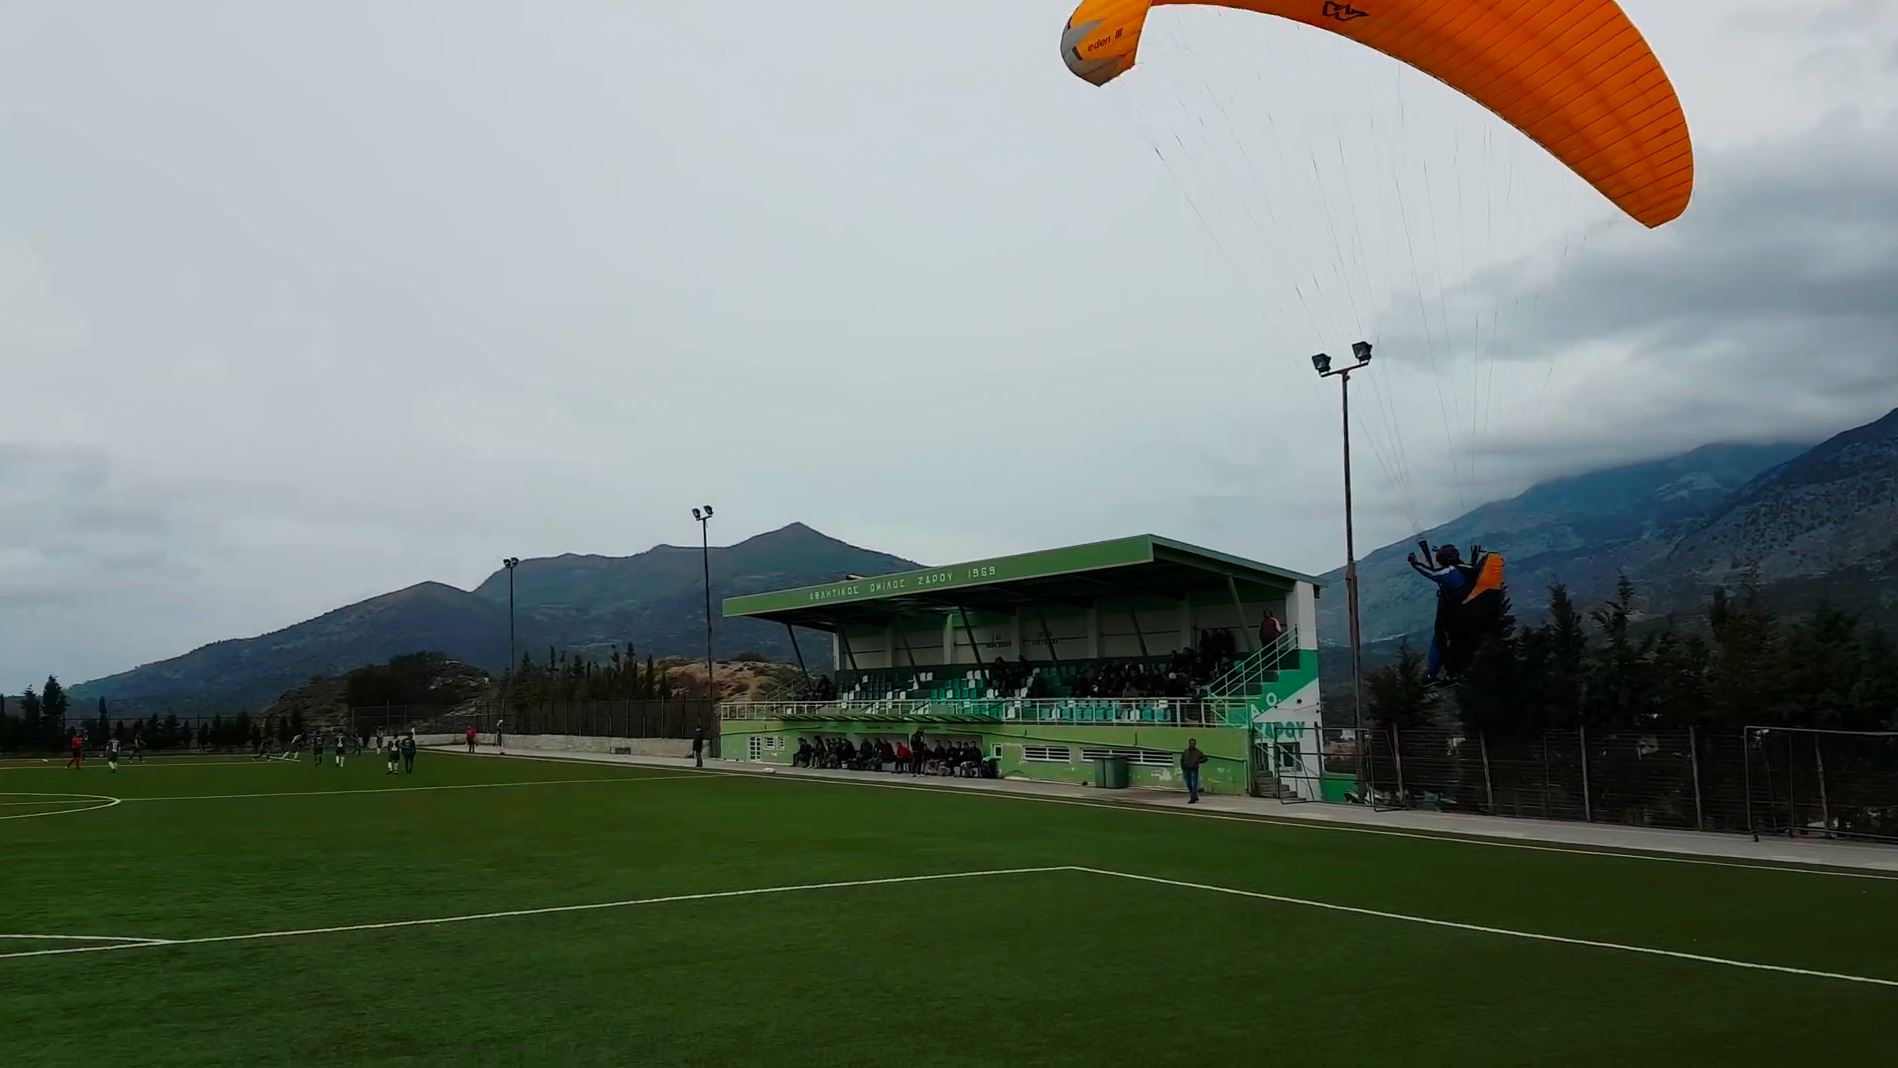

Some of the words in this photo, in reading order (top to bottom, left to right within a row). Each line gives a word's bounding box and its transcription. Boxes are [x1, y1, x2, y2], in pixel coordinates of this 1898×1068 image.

[1087, 36, 1111, 52] eden
[869, 579, 905, 592] ΟΜΙΛΟΣ
[918, 572, 952, 585] ΖΑΡΟΥ
[968, 566, 996, 579] 1969
